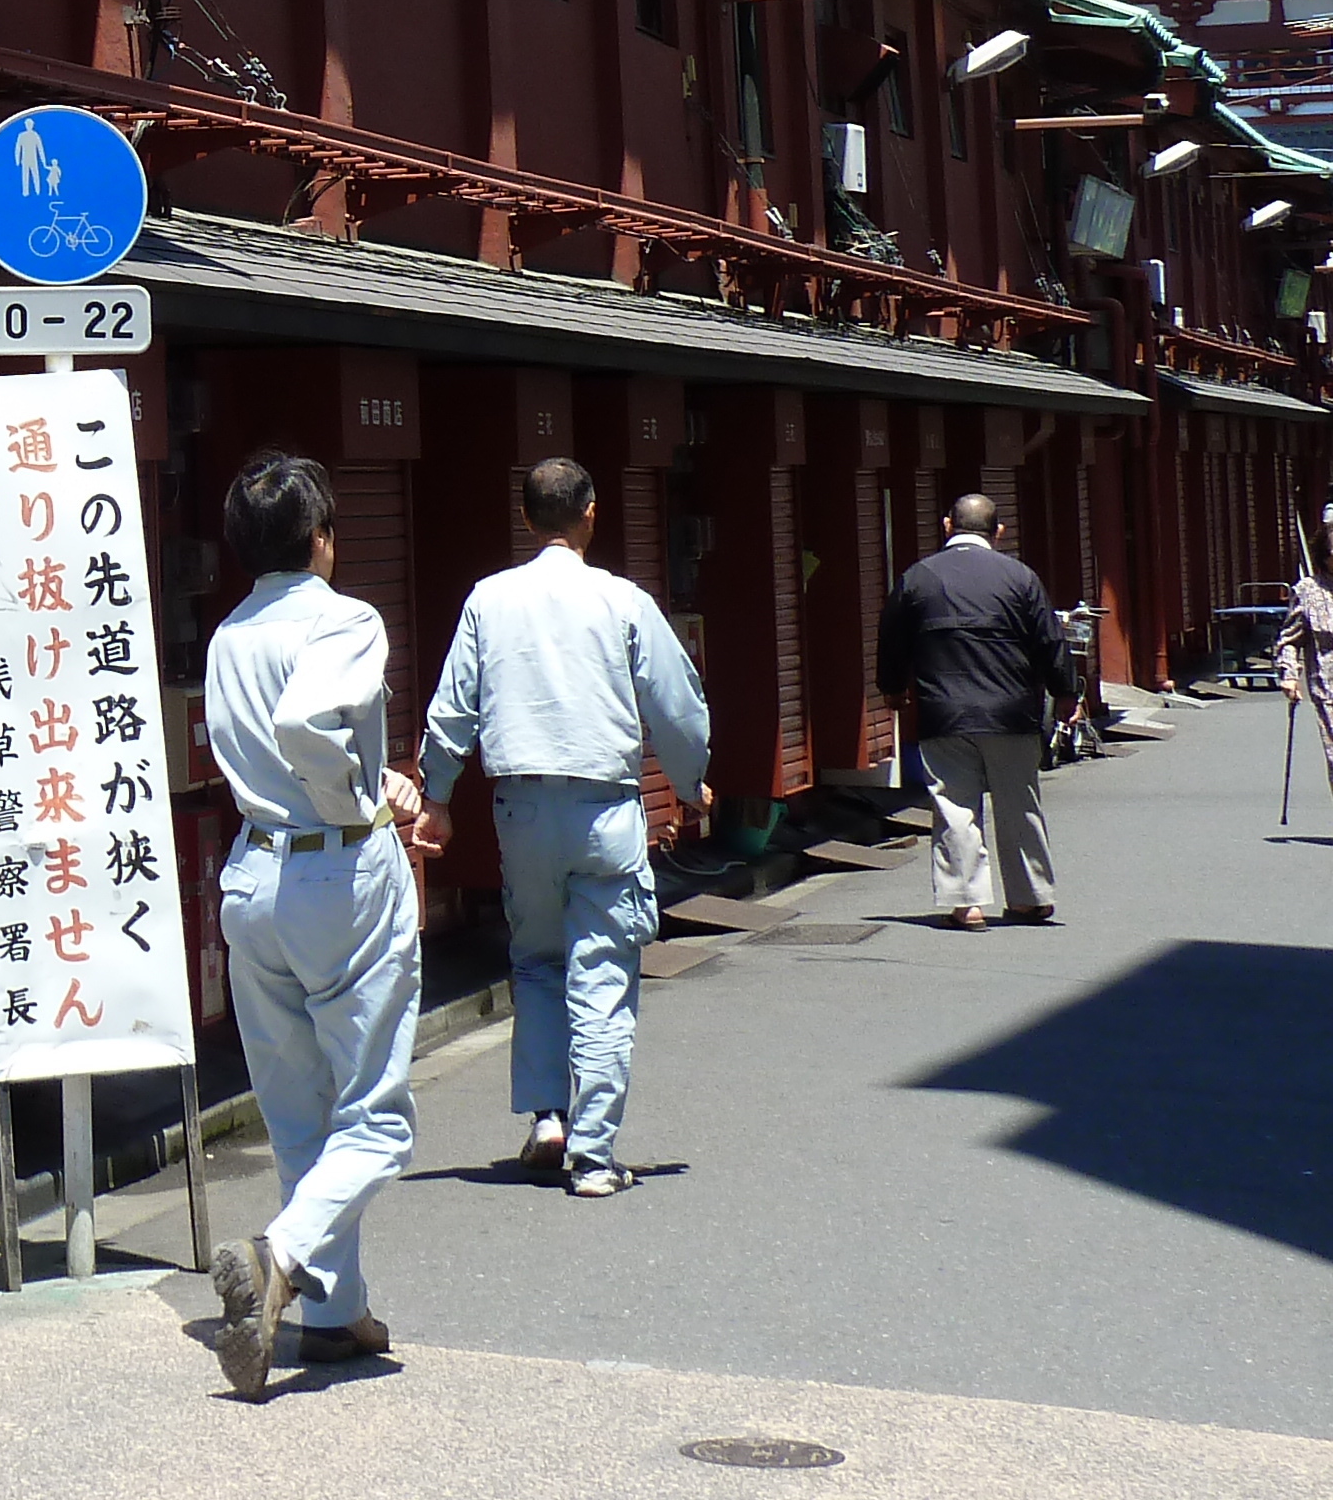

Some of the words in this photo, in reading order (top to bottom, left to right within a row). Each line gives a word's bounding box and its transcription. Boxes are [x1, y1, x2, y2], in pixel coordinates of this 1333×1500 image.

[5, 415, 105, 1030] 通り抜け出来ません
[73, 417, 161, 953] この先道路が狭く
